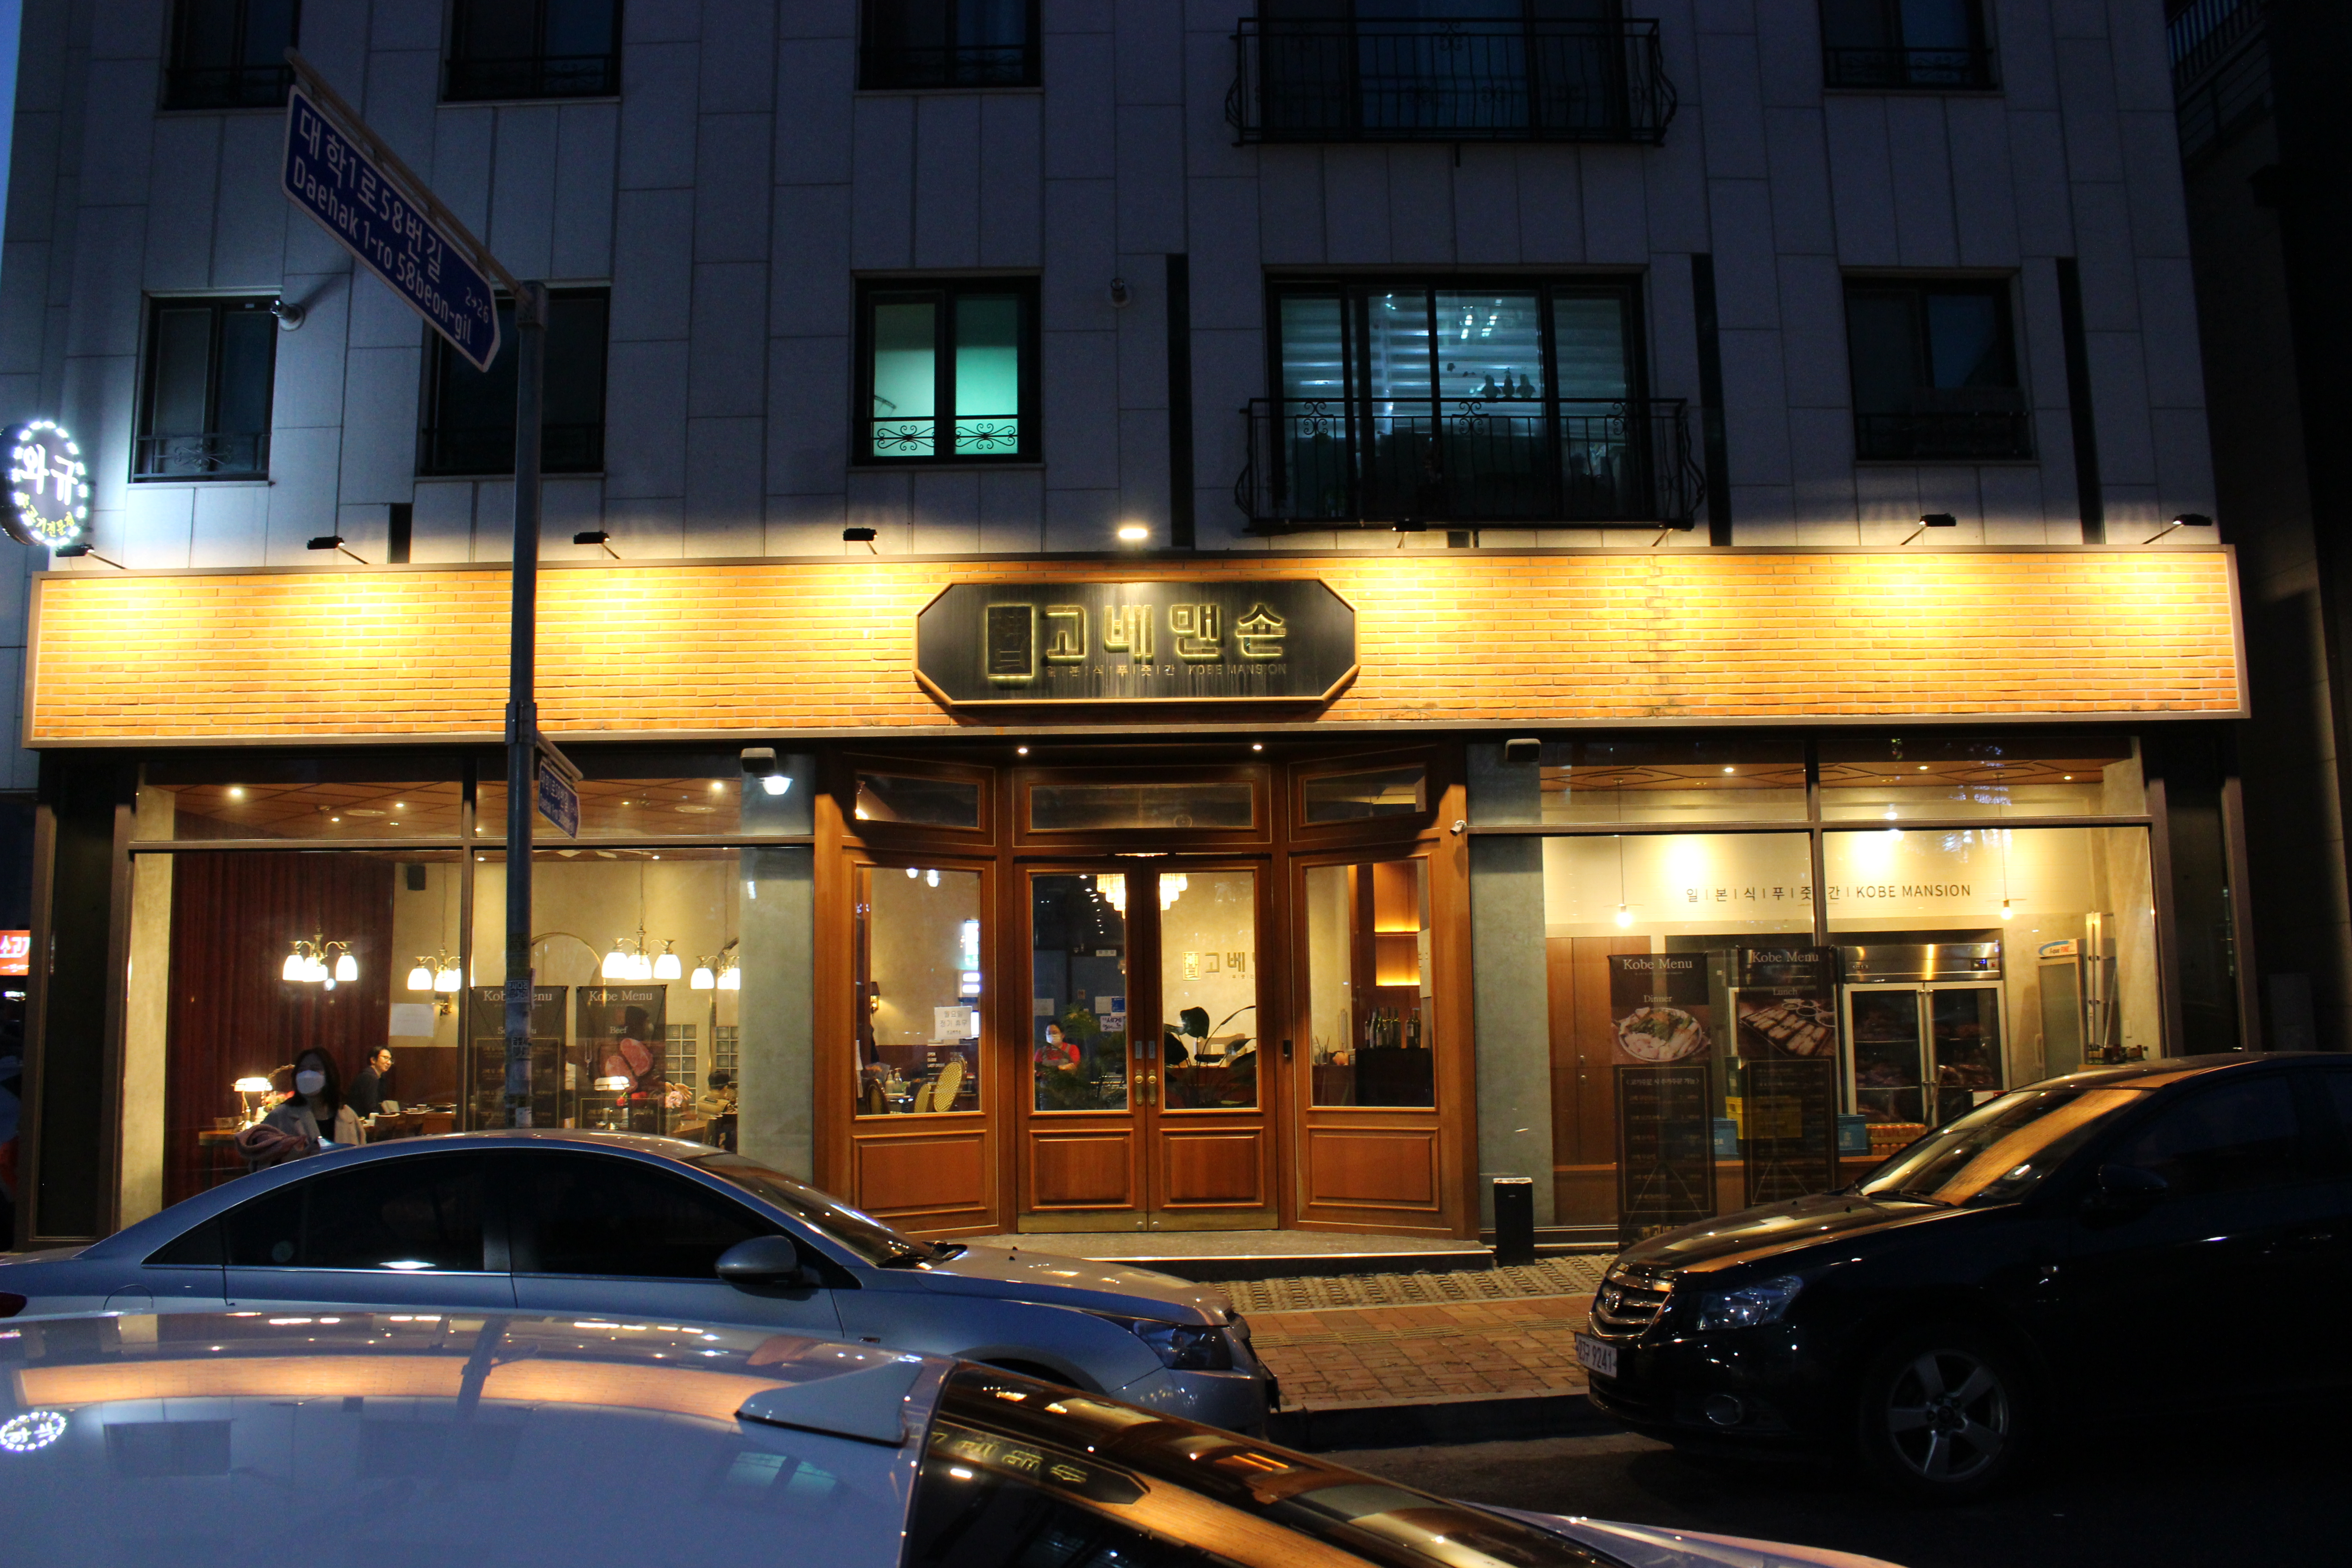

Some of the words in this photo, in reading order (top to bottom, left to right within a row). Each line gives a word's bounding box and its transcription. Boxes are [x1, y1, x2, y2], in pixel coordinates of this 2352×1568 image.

[293, 156, 358, 239] Daehak
[363, 221, 393, 270] 1-ro
[397, 251, 471, 345] 58beon-gil
[20, 443, 78, 505] 와규
[1188, 665, 1222, 675] KOBE
[1856, 886, 1896, 898] KOBE
[1902, 884, 1971, 897] MANSION
[1752, 951, 1782, 962] Kobe
[1786, 951, 1819, 962] Menu
[1622, 959, 1655, 970] Kobe
[1658, 958, 1693, 969] Menu
[622, 990, 653, 1001] Menu
[1643, 995, 1672, 1003] Dinner
[609, 1026, 628, 1034] Beef
[1592, 1345, 1612, 1372] 9241
